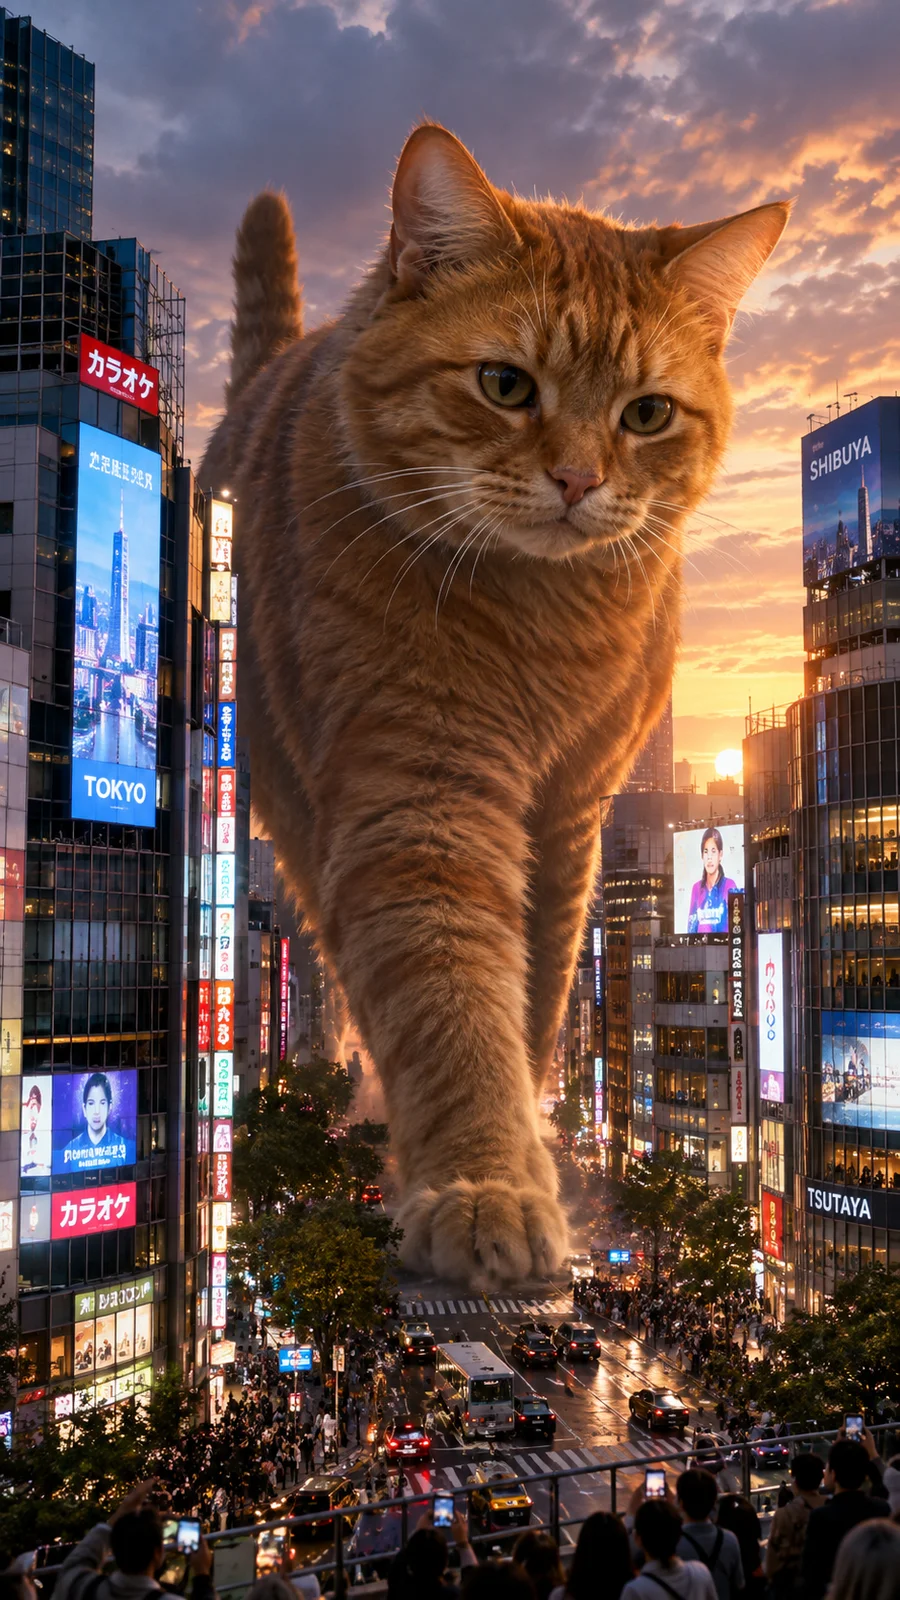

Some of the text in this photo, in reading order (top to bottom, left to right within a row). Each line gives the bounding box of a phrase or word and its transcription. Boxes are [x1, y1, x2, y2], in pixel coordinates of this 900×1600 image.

[87, 349, 154, 399] カラオケ
[810, 435, 872, 481] SHIBUYA
[84, 775, 146, 804] TOKYO
[59, 1192, 131, 1228] カラオケ
[807, 1186, 872, 1220] TSUTAYA
